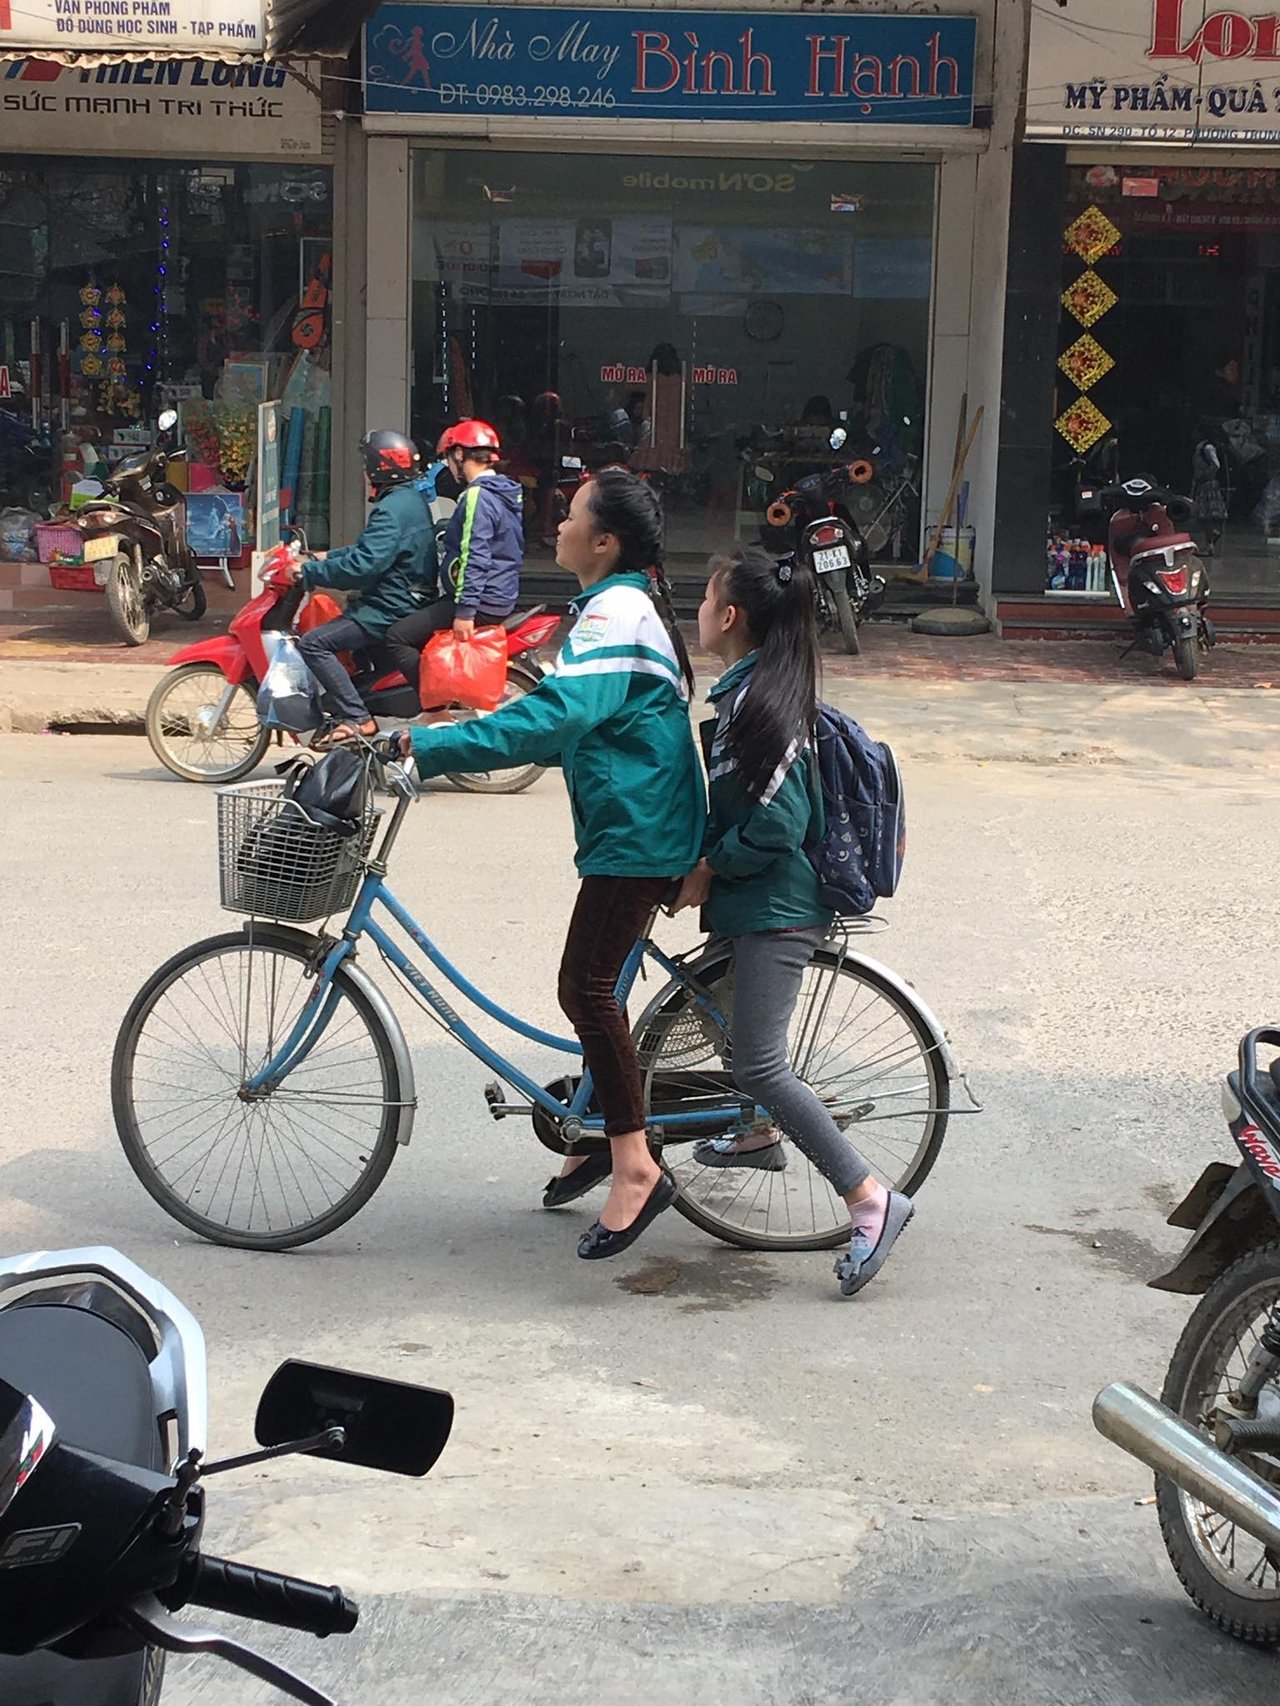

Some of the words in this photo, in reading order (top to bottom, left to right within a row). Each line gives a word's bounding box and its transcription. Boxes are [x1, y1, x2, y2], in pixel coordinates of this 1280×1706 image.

[117, 19, 142, 37] HỌC
[147, 20, 178, 34] SINH
[432, 17, 516, 60] Nhà
[528, 20, 620, 80] May
[631, 28, 776, 95] Bình
[804, 31, 963, 115] Hạnh
[3, 89, 57, 112] SỨC
[210, 95, 283, 118] THỨC
[476, 84, 616, 108] 0983.298.246
[1064, 76, 1107, 110] MỸ
[626, 366, 647, 383] RA
[717, 367, 737, 385] RA
